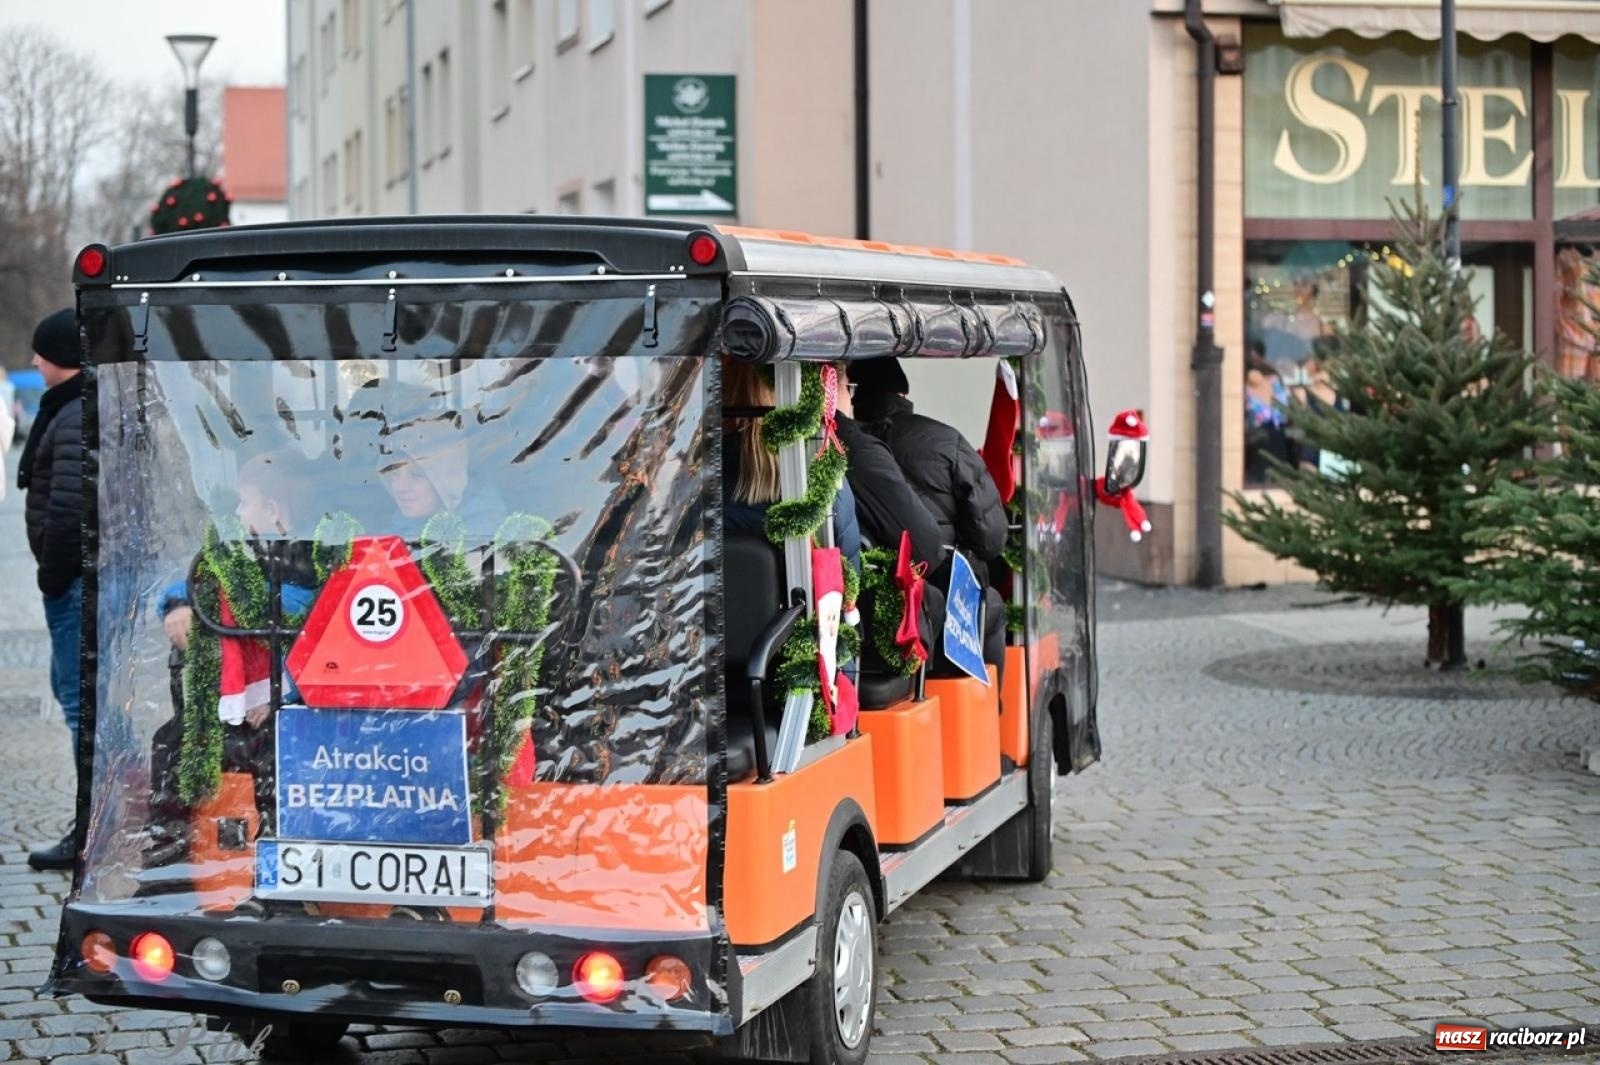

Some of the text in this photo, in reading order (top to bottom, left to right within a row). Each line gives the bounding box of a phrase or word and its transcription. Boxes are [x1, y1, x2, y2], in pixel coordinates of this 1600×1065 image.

[356, 596, 397, 627] 25
[312, 745, 429, 778] Atrakcja
[287, 783, 459, 812] BEZPŁATNA
[260, 871, 276, 885] PL
[350, 850, 480, 898] CORAL
